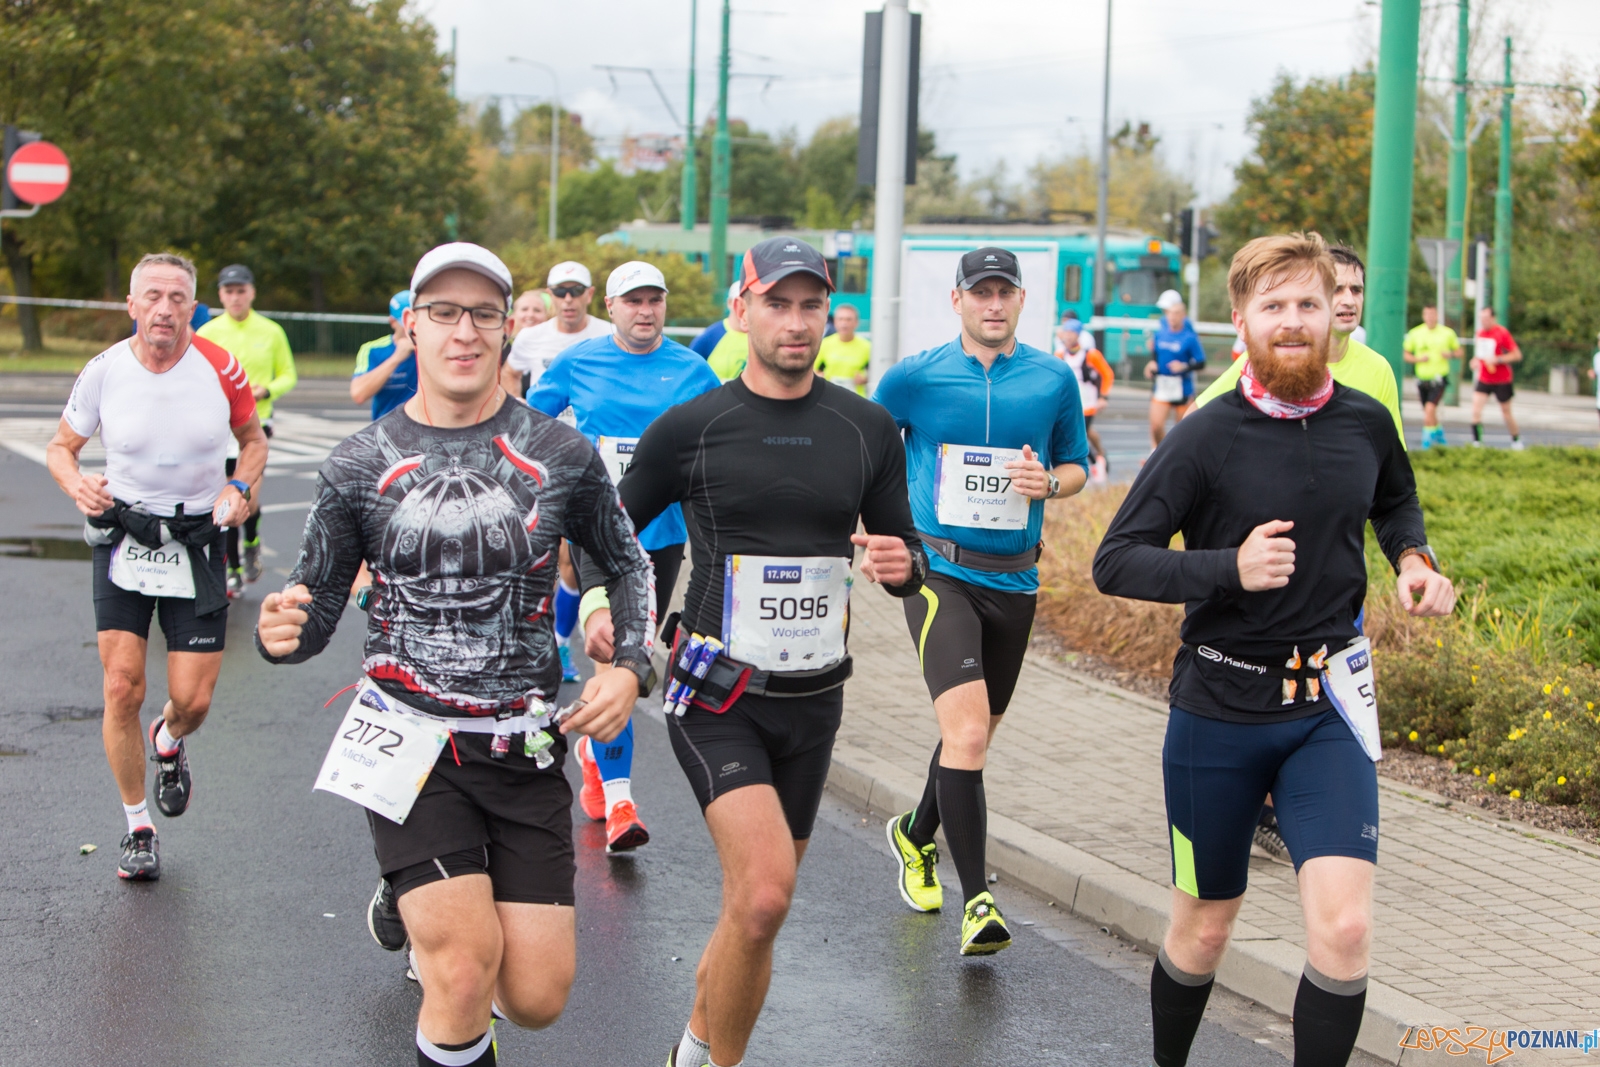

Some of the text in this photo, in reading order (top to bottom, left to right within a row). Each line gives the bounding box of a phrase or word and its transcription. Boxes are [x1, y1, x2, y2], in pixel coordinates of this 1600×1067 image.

[965, 474, 1013, 494] 6197
[967, 495, 1007, 506] Krzysztof
[126, 545, 181, 567] 5404
[759, 594, 829, 621] 5096
[771, 626, 820, 639] Wojciech
[1223, 655, 1267, 675] Kalenji
[1357, 682, 1376, 708] 5
[343, 717, 404, 758] 2172
[340, 746, 378, 770] Michał
